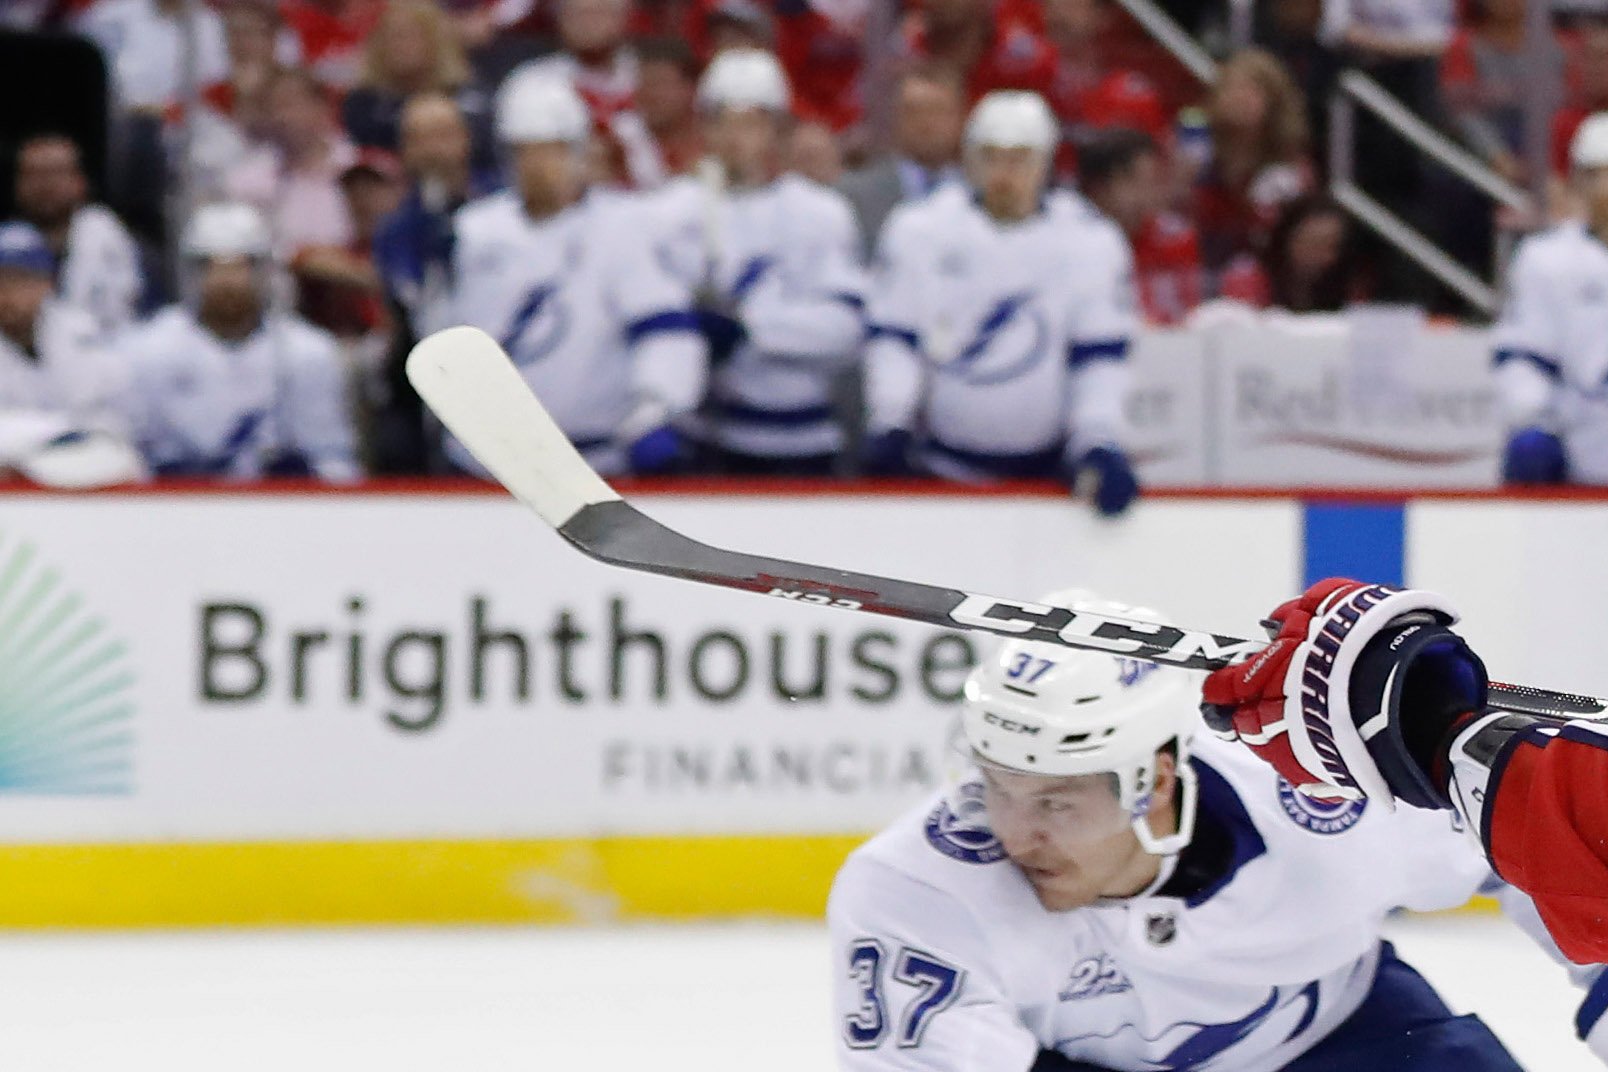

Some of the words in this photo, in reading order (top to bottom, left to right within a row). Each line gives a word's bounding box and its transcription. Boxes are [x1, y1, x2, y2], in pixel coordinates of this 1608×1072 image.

[949, 594, 1270, 662] CCM
[197, 596, 978, 732] Brighthouse
[1006, 652, 1056, 683] 37
[983, 710, 1041, 735] CCM
[607, 742, 942, 792] FINANCIA
[843, 937, 966, 1050] 37
